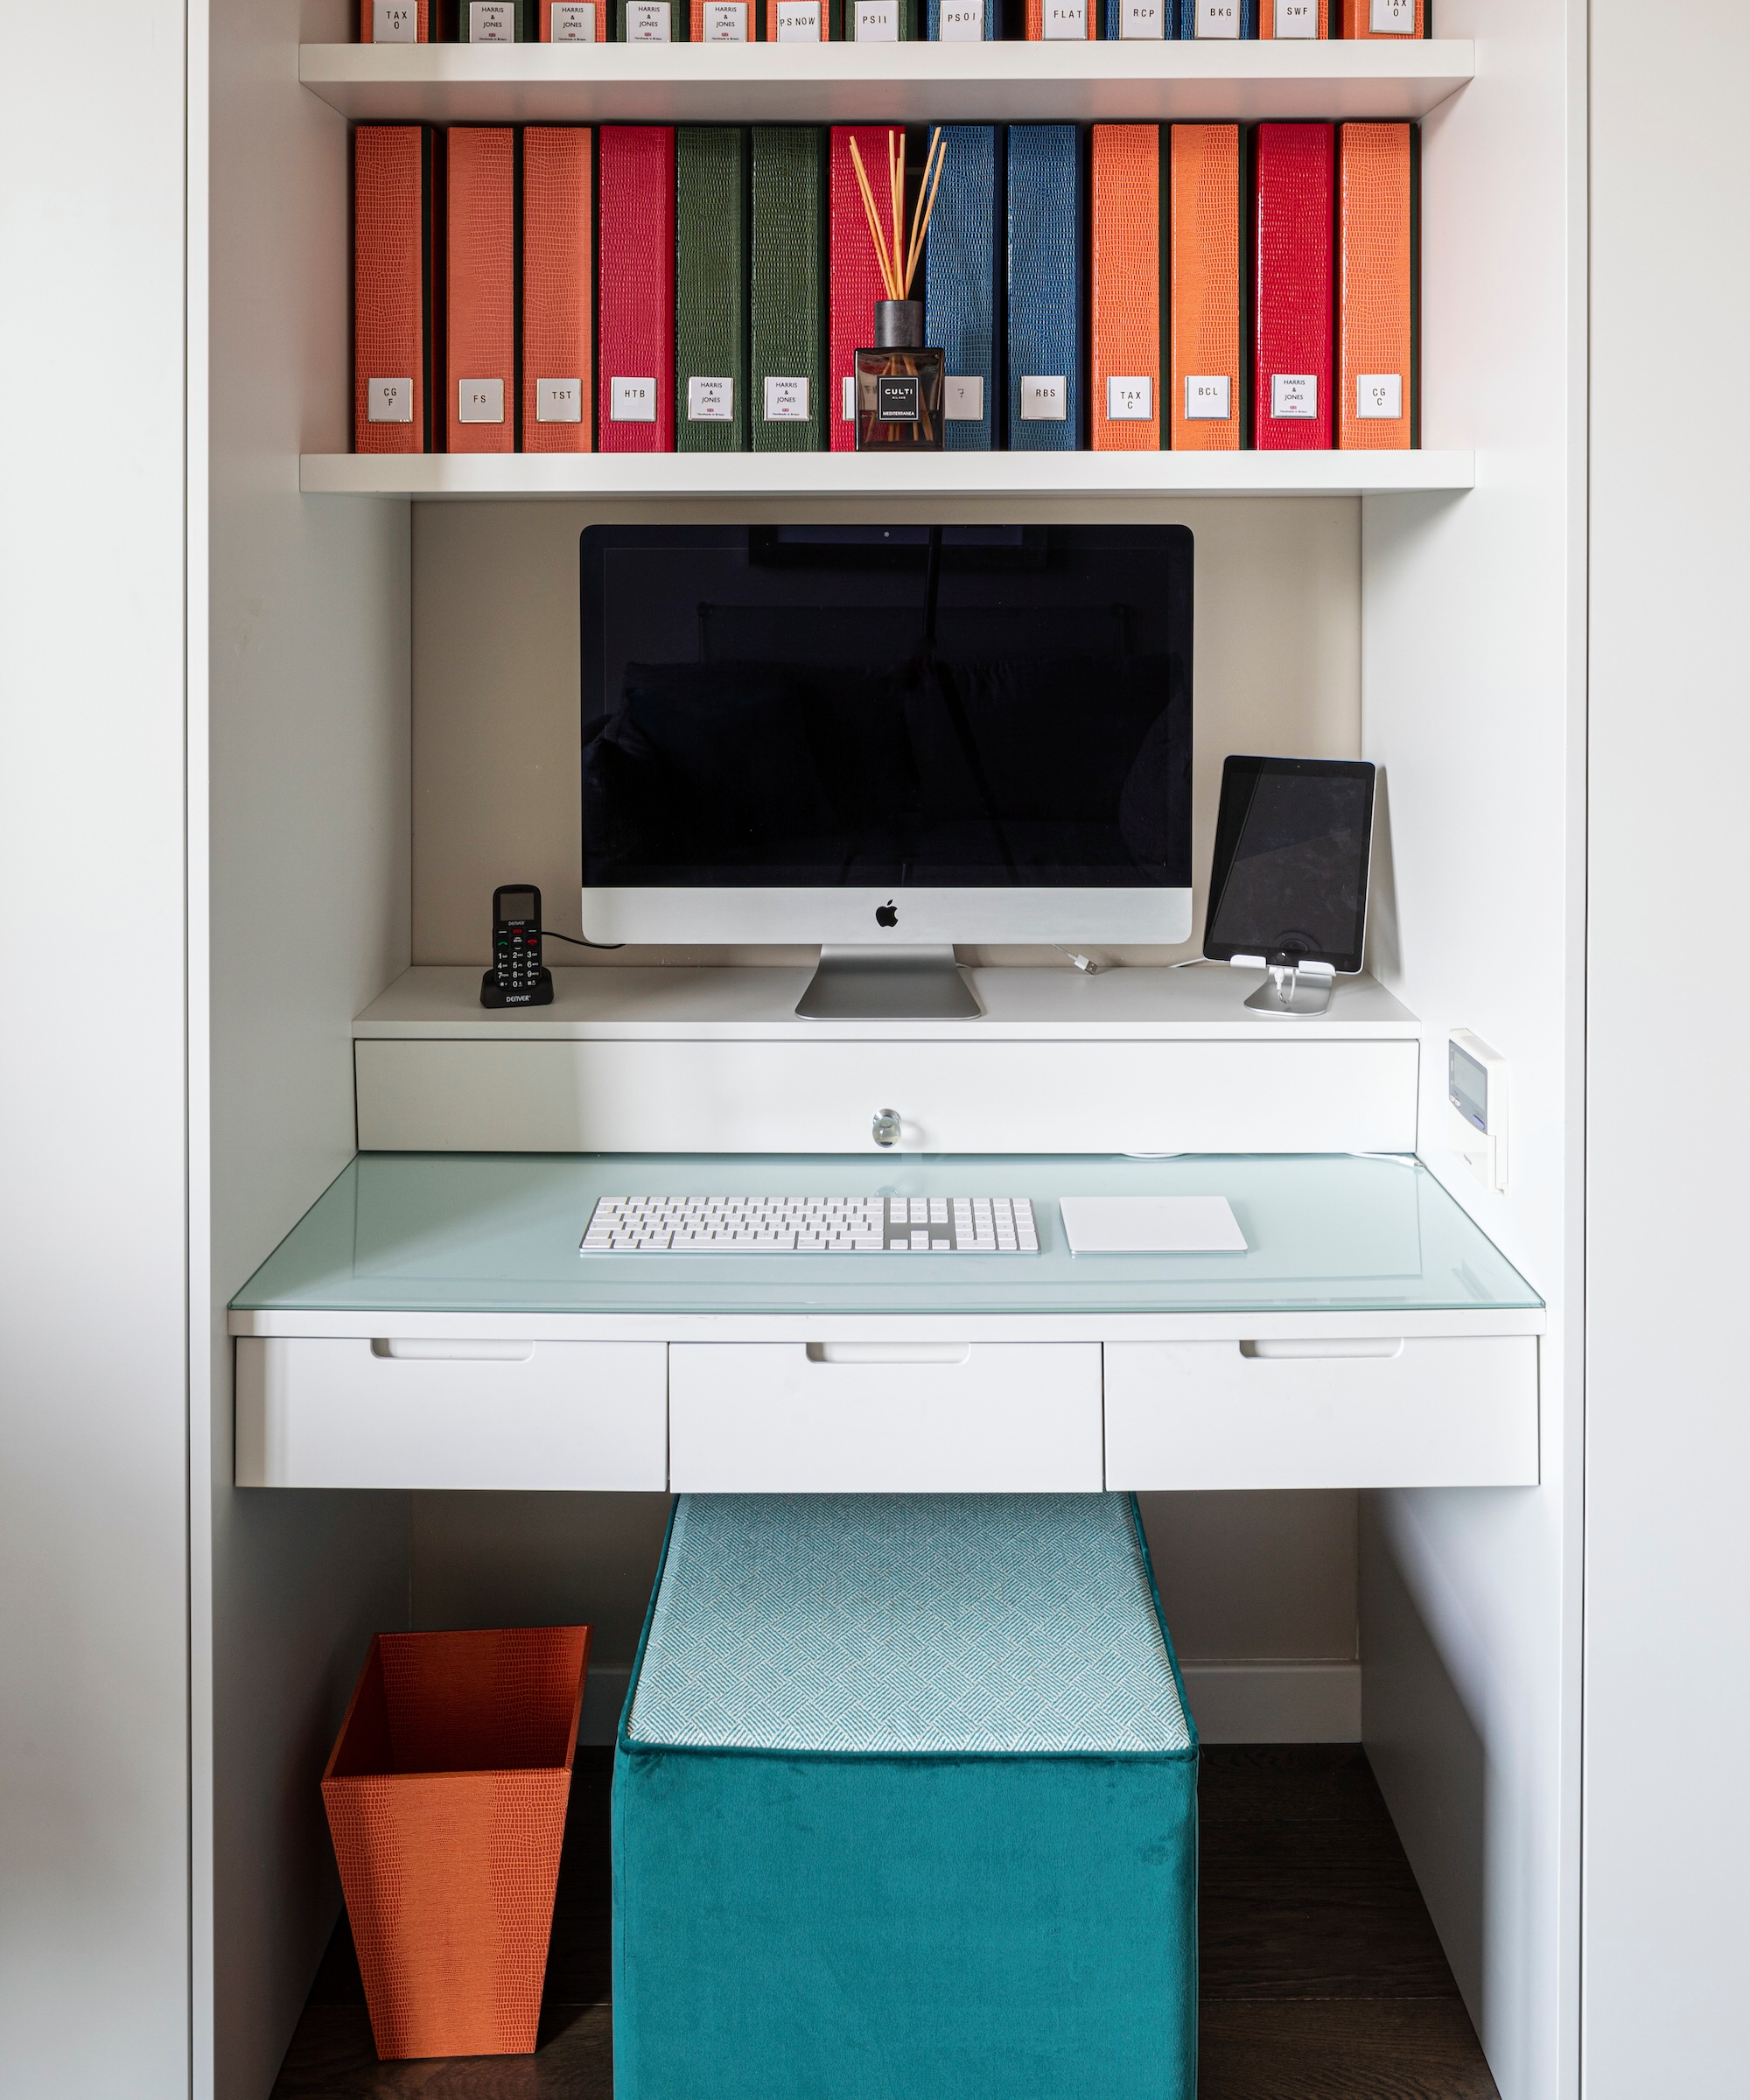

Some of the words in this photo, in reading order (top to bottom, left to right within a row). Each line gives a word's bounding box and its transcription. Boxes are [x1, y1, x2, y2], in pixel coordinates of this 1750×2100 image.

[386, 10, 408, 20] TAX
[1053, 10, 1083, 18] FLAT
[1132, 9, 1155, 18] RCP
[1209, 8, 1233, 17] BKG
[1286, 7, 1309, 16] SWF
[383, 387, 397, 397] CG
[551, 390, 572, 400] TST
[624, 388, 646, 399] HTB
[1035, 388, 1056, 398] RBS
[1120, 390, 1142, 400] TAX
[1198, 387, 1219, 396] BCL
[1372, 388, 1386, 397] CG
[388, 397, 394, 407] F
[472, 395, 486, 403] FS
[1376, 397, 1382, 406] C
[1127, 401, 1133, 410] C
